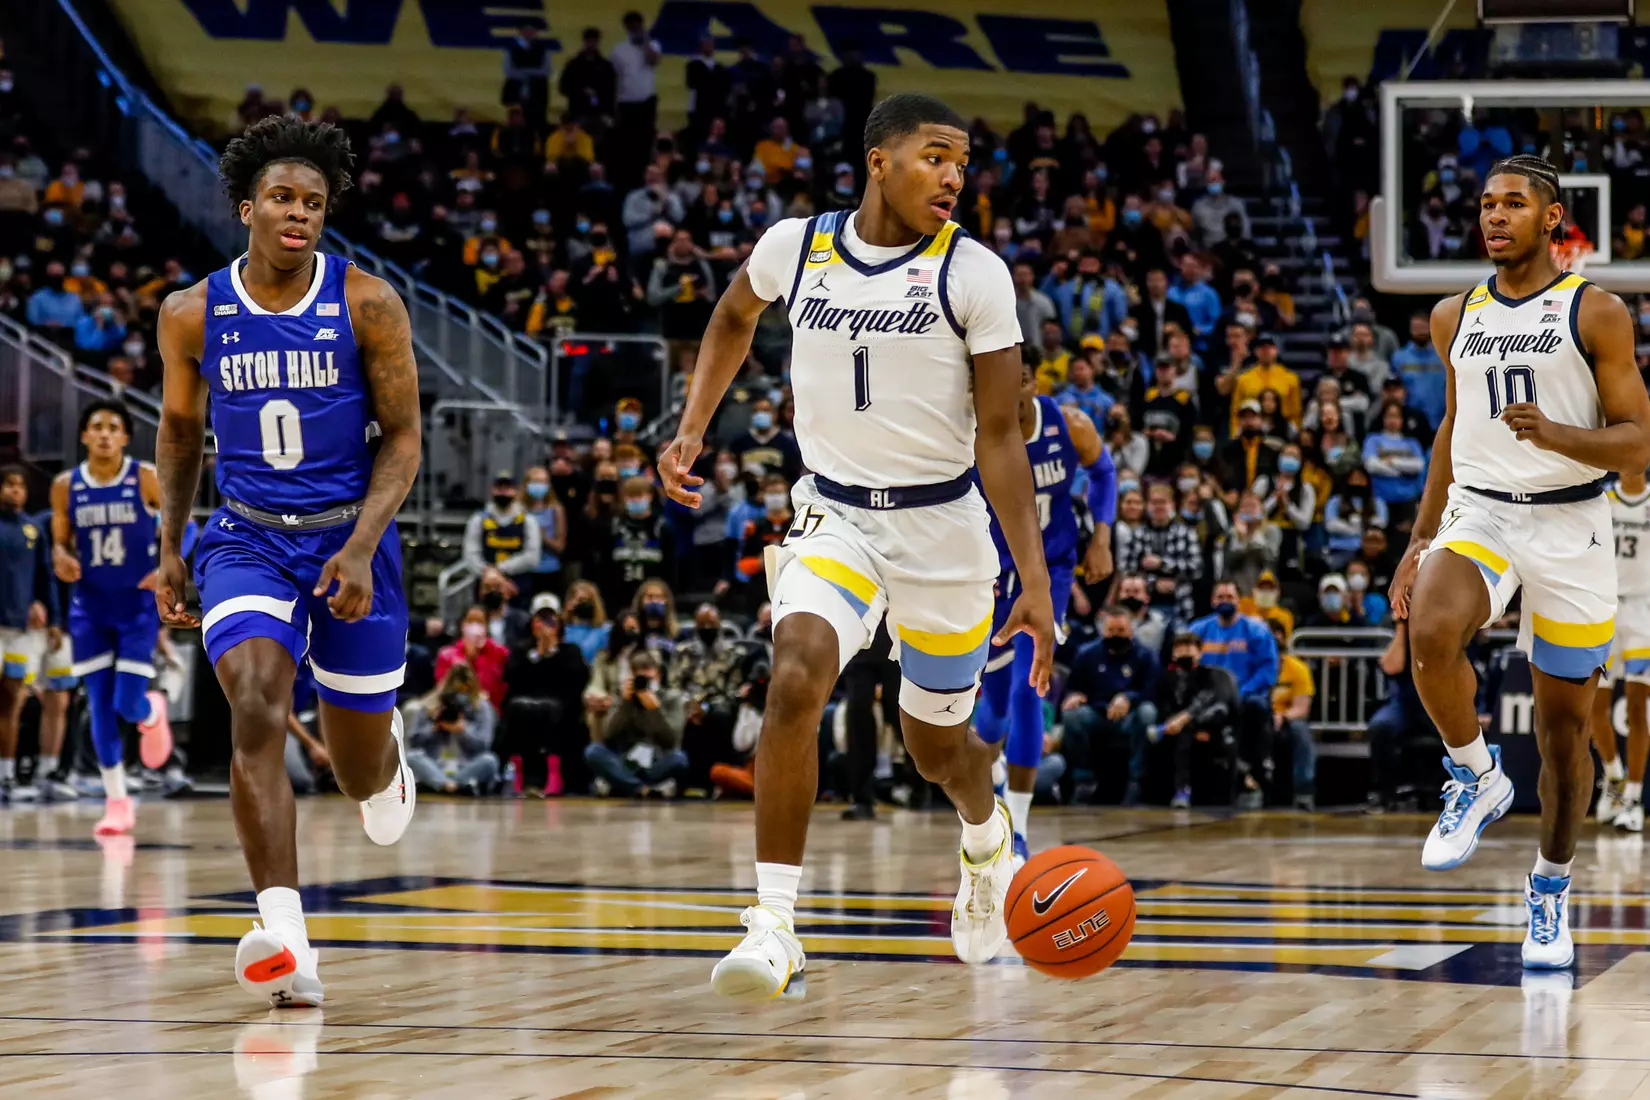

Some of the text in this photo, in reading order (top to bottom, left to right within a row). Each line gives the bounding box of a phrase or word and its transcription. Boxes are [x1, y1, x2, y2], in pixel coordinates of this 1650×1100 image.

[180, 0, 1131, 78] WE ARE
[796, 297, 940, 341] Marquette
[1460, 328, 1562, 361] Marquette
[220, 350, 339, 392] SETON HALL
[853, 346, 872, 411] 1
[1485, 364, 1537, 419] 10
[259, 399, 304, 470] 0
[870, 489, 896, 508] AL
[88, 527, 126, 568] 14
[1051, 907, 1111, 950] ELITE
